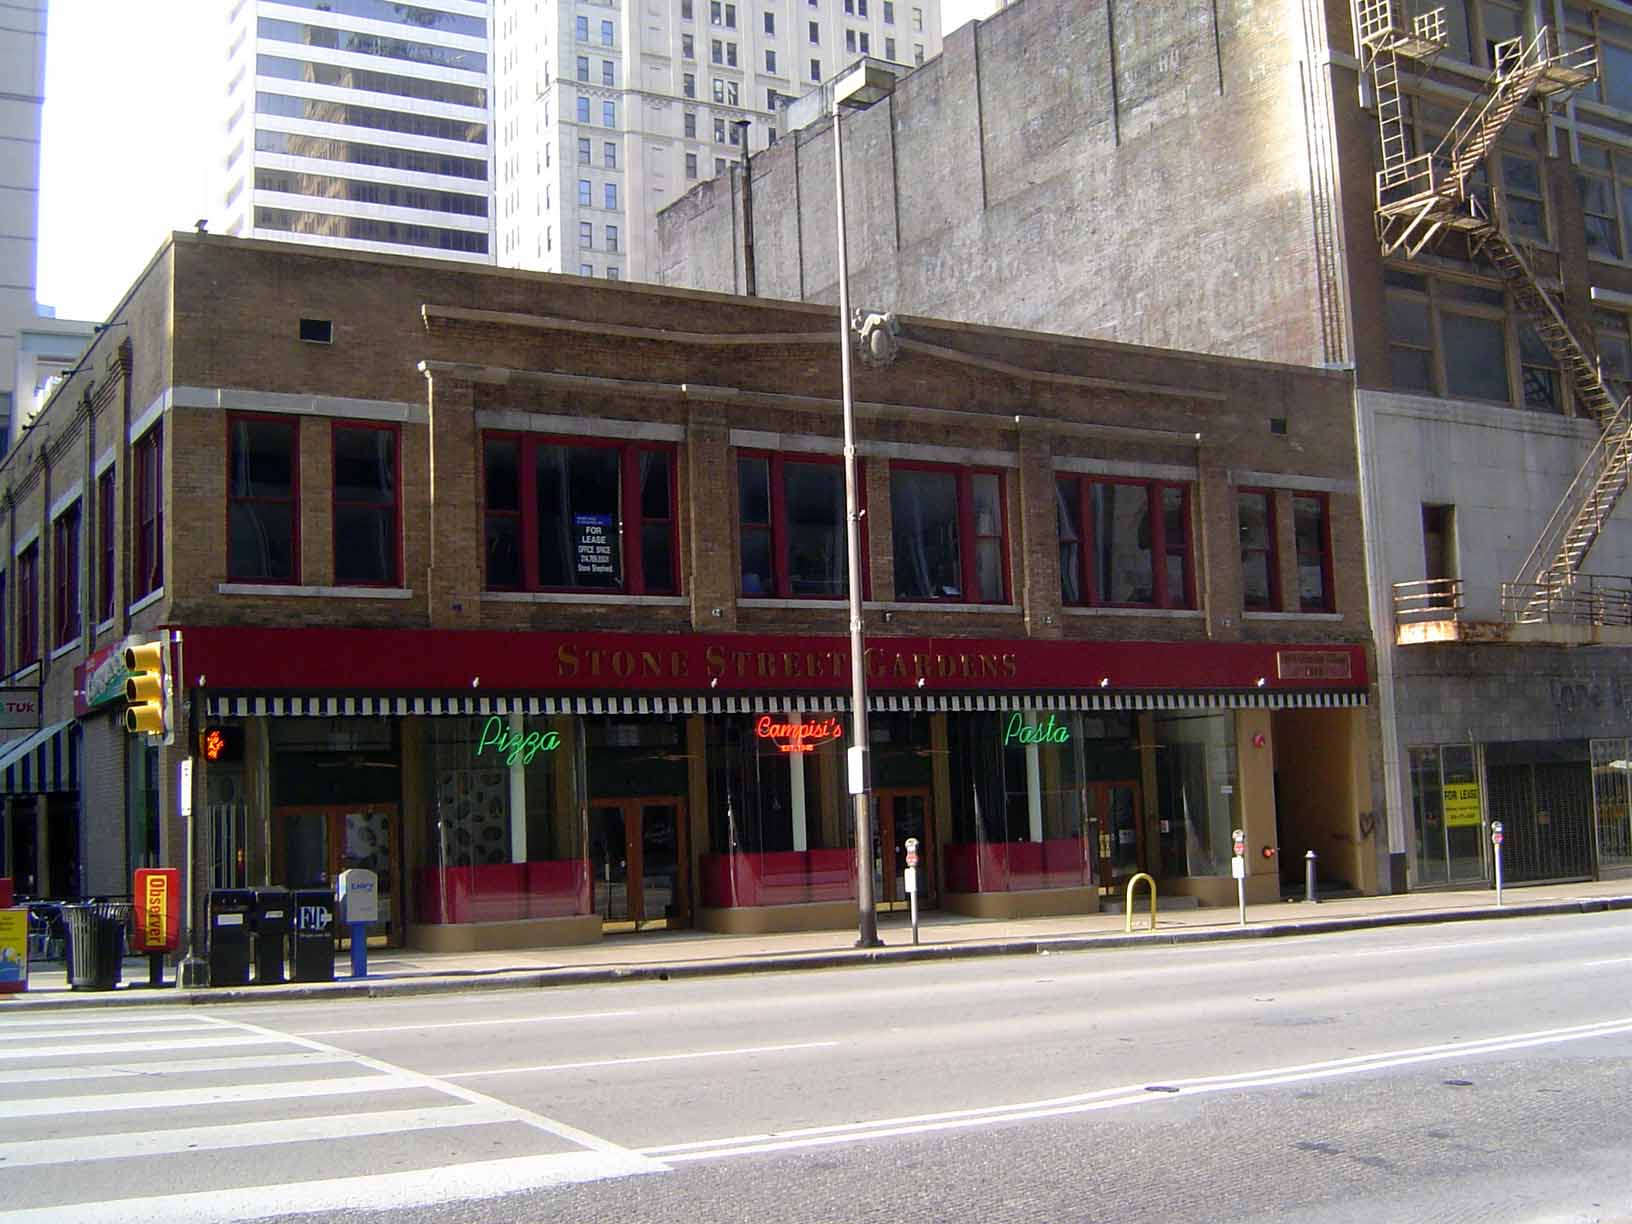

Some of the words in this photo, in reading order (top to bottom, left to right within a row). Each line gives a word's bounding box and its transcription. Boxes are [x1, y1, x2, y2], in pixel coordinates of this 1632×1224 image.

[582, 535, 607, 544] LEASE
[585, 526, 602, 535] FOR
[558, 644, 690, 678] STONE
[705, 646, 850, 678] STREET
[864, 647, 1018, 679] GARDENS
[478, 716, 561, 767] Pizza
[757, 715, 843, 744] Campisi's
[1004, 712, 1070, 746] Pasta
[1444, 790, 1458, 801] FOR
[1459, 789, 1478, 800] LEASE
[149, 878, 165, 945] Observer
